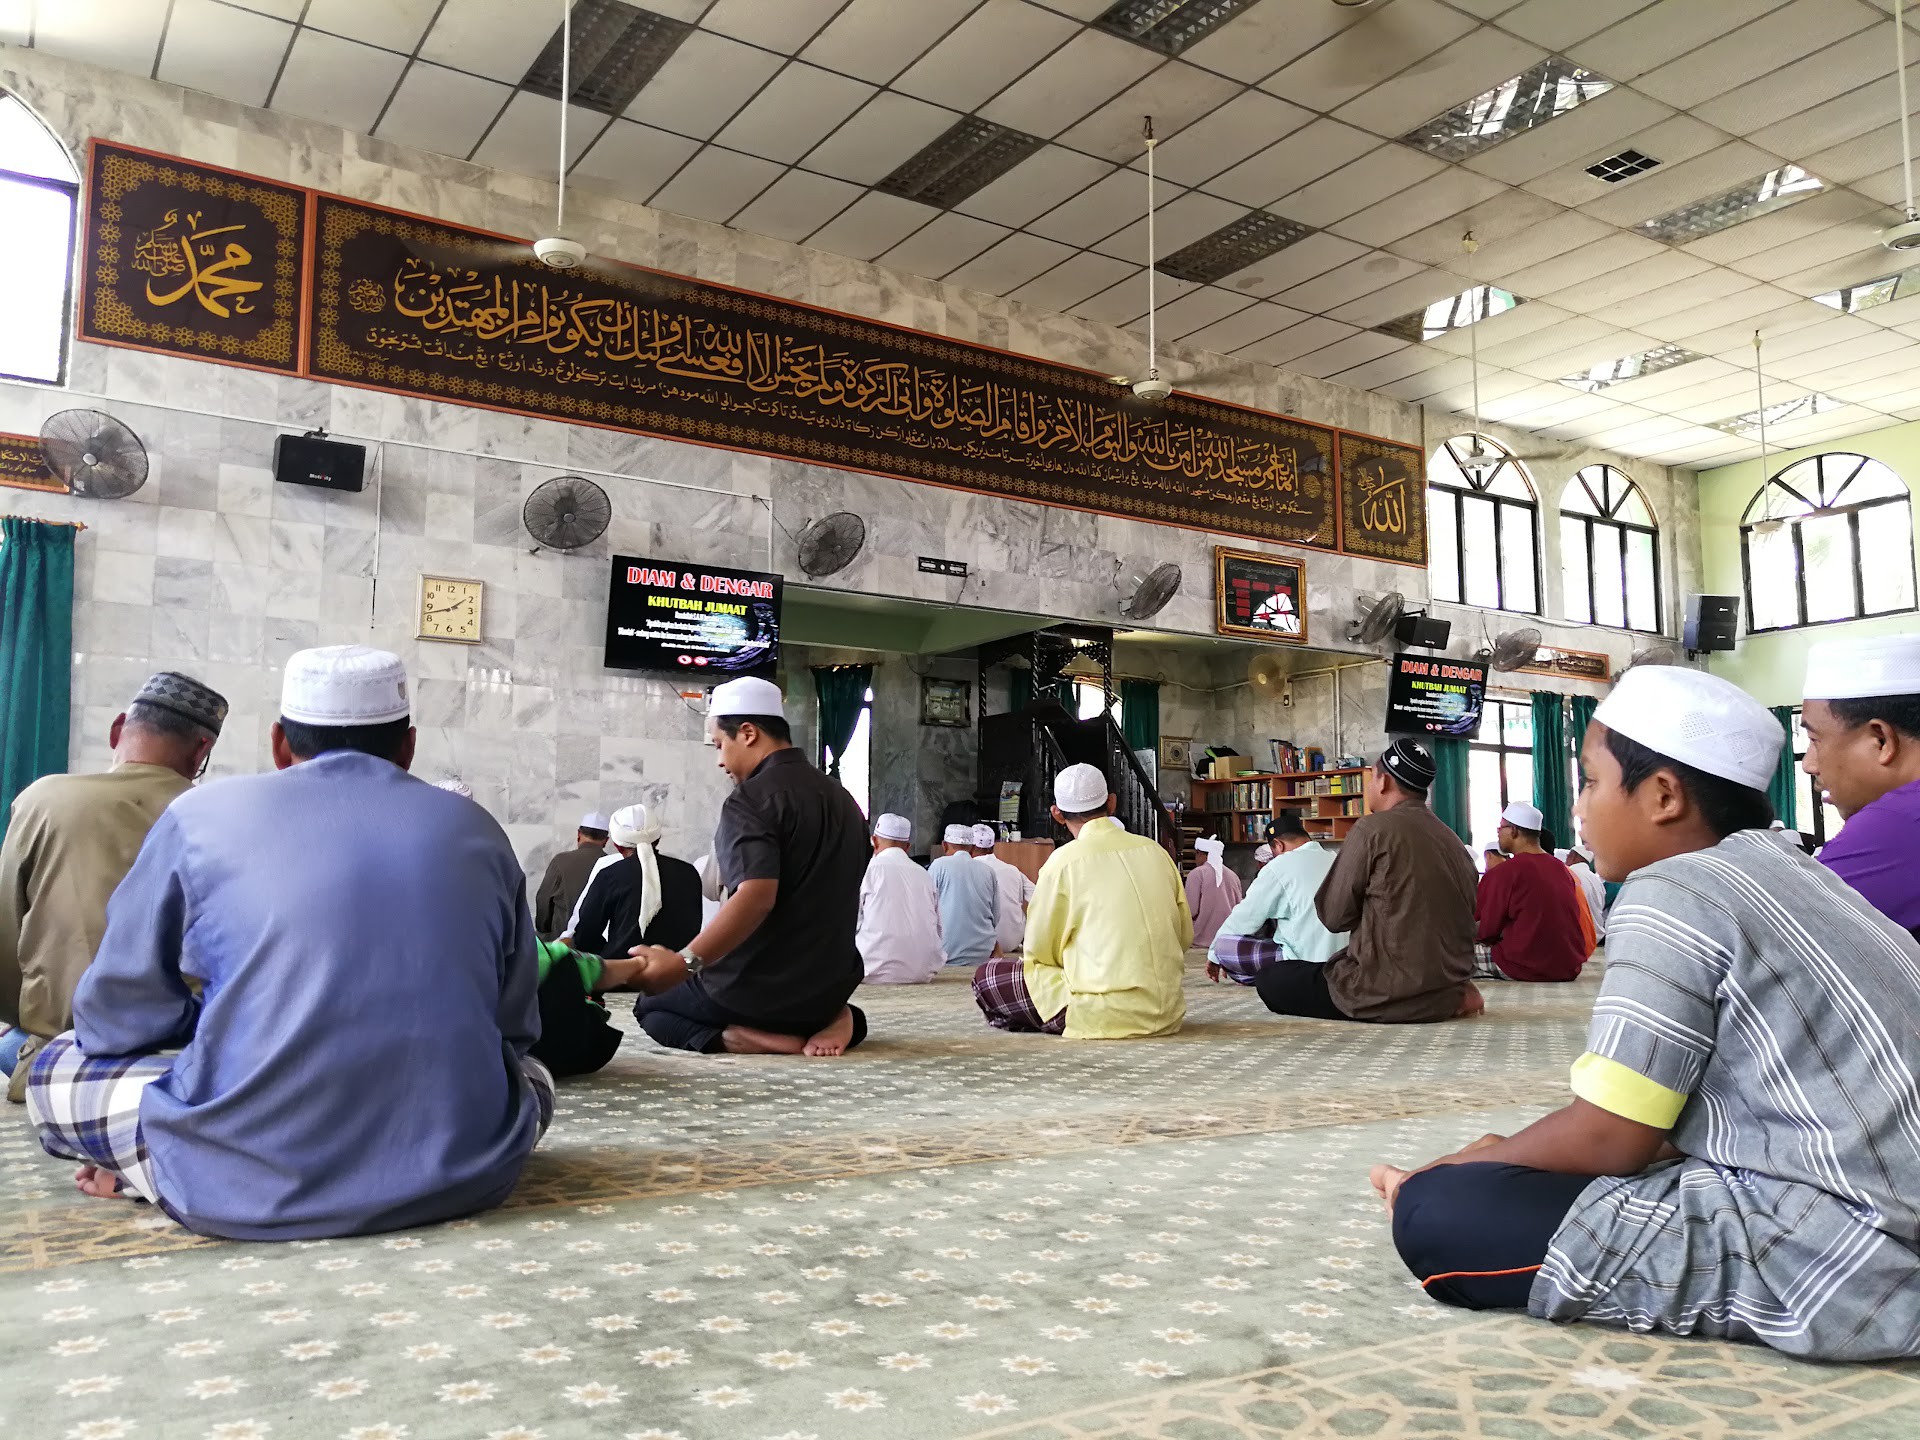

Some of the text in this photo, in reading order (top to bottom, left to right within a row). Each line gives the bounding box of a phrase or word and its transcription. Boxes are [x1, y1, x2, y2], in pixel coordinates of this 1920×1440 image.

[627, 566, 774, 599] DIAM & DENGAR
[648, 595, 748, 616] KHUTBAH JUMAAT
[446, 625, 453, 633] 6
[1401, 660, 1483, 682] DIAM & DENGAR
[1411, 680, 1468, 694] KHUTBAH JUMAAT
